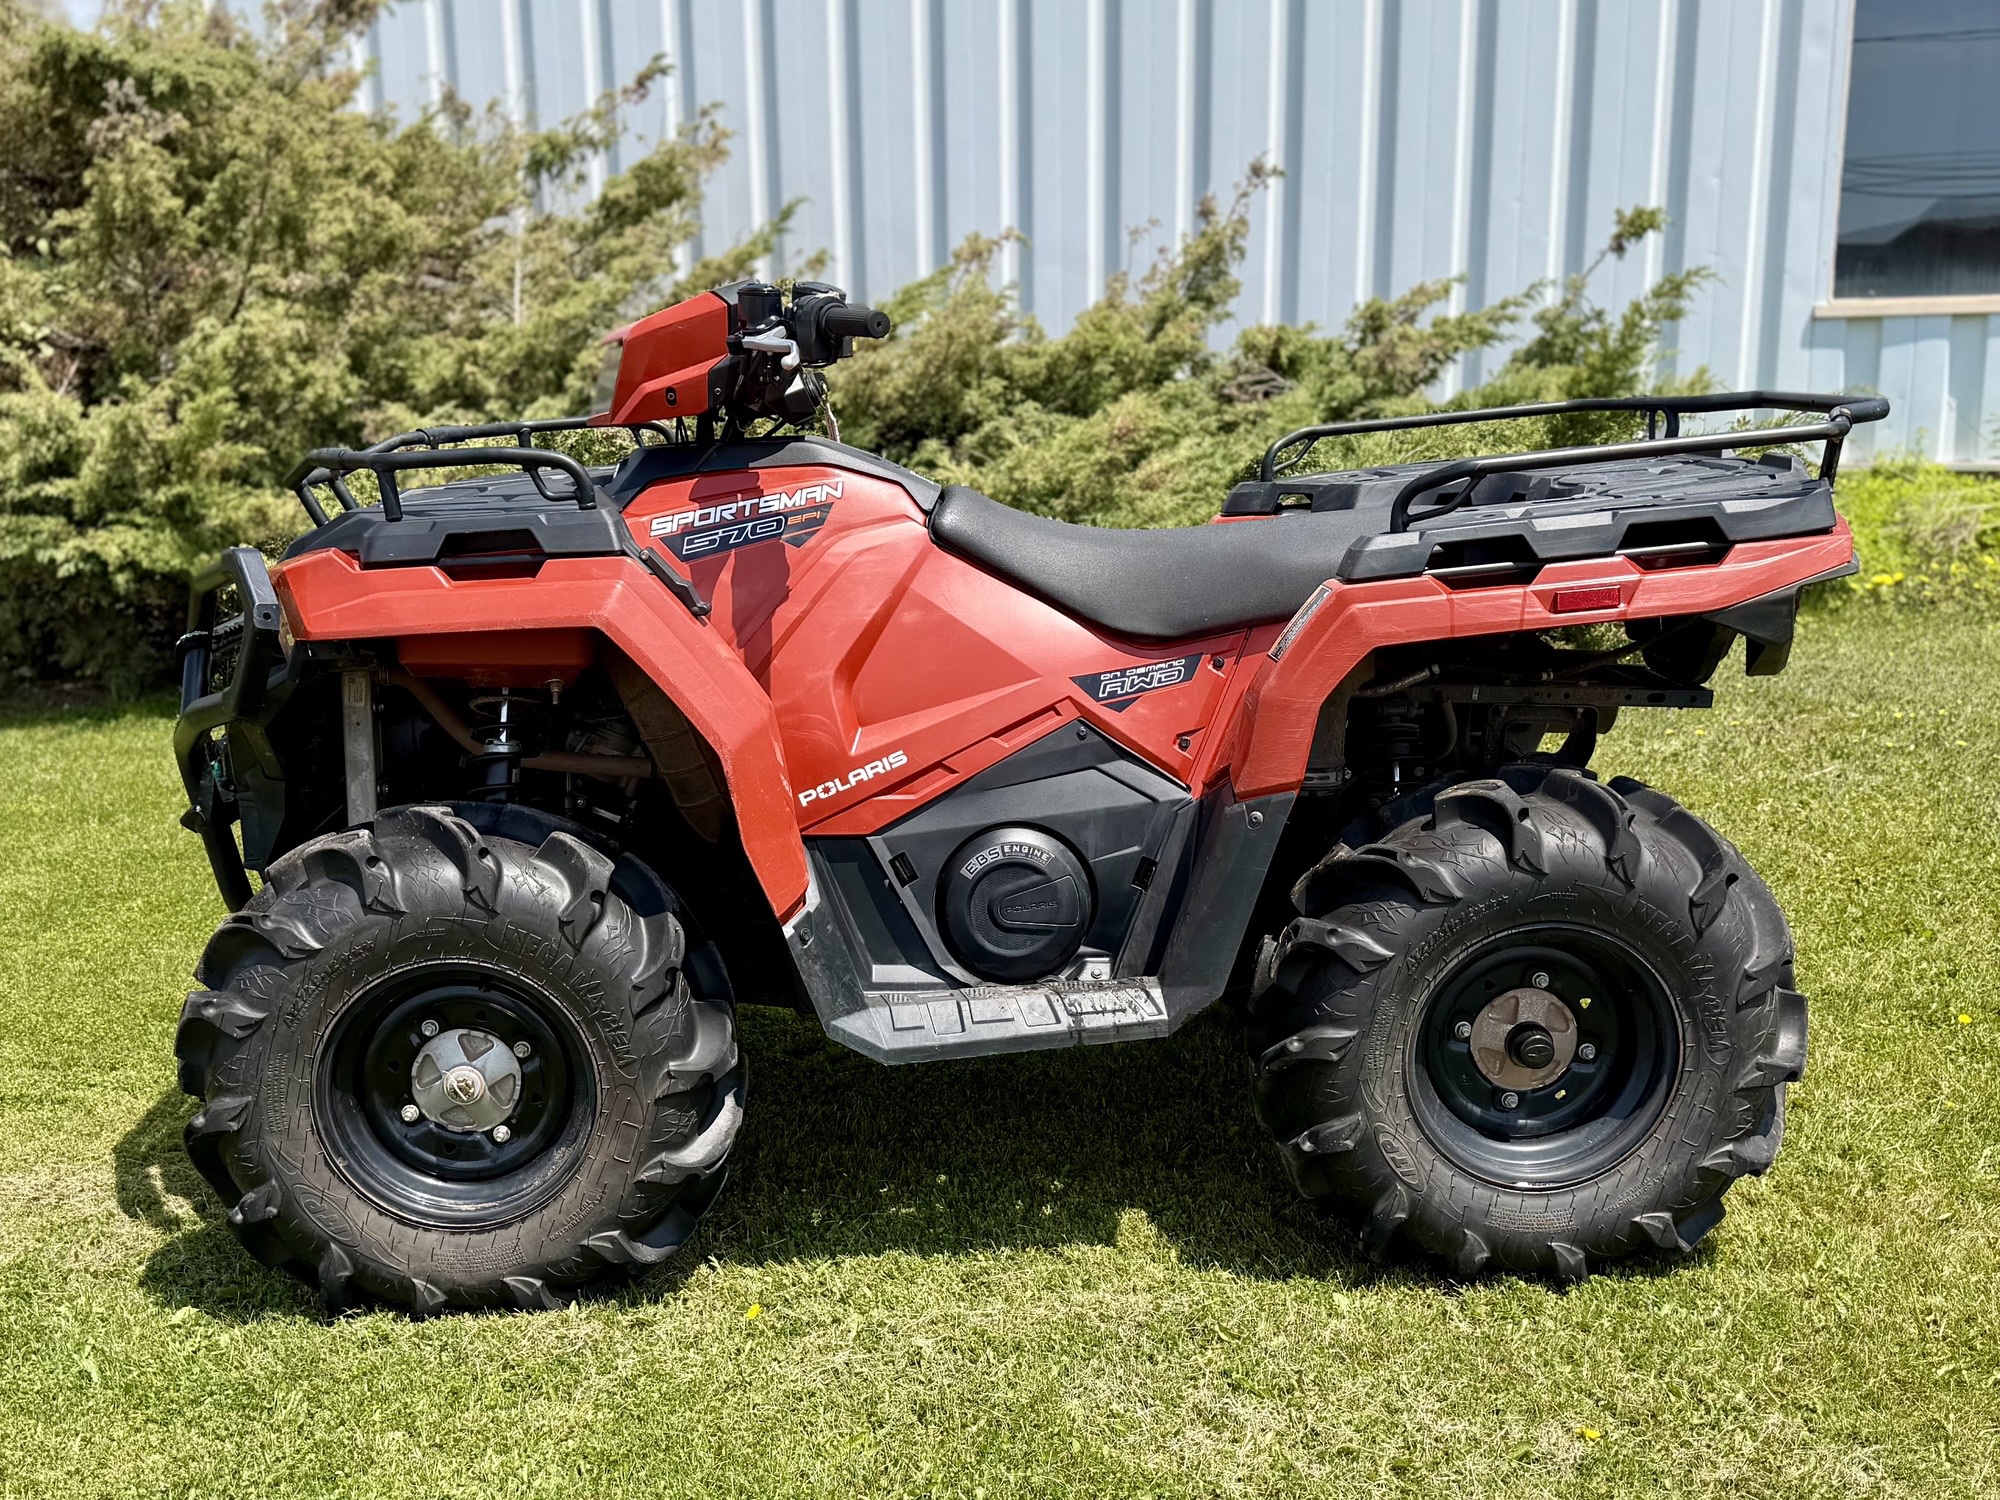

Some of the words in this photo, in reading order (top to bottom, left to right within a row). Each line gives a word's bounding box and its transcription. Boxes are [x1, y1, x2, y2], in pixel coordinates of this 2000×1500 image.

[650, 481, 844, 537] SPORTSMAN
[682, 515, 785, 555] 570
[1099, 666, 1185, 697] AWD
[1101, 672, 1121, 681] ON
[1126, 659, 1186, 675] DEMAND
[798, 749, 908, 807] POLARIS
[964, 846, 1000, 875] EBS
[1003, 845, 1050, 862] ENGINE
[1004, 900, 1059, 914] POLARIS
[1381, 1138, 1418, 1178] ITP
[302, 1196, 350, 1238] ITP
